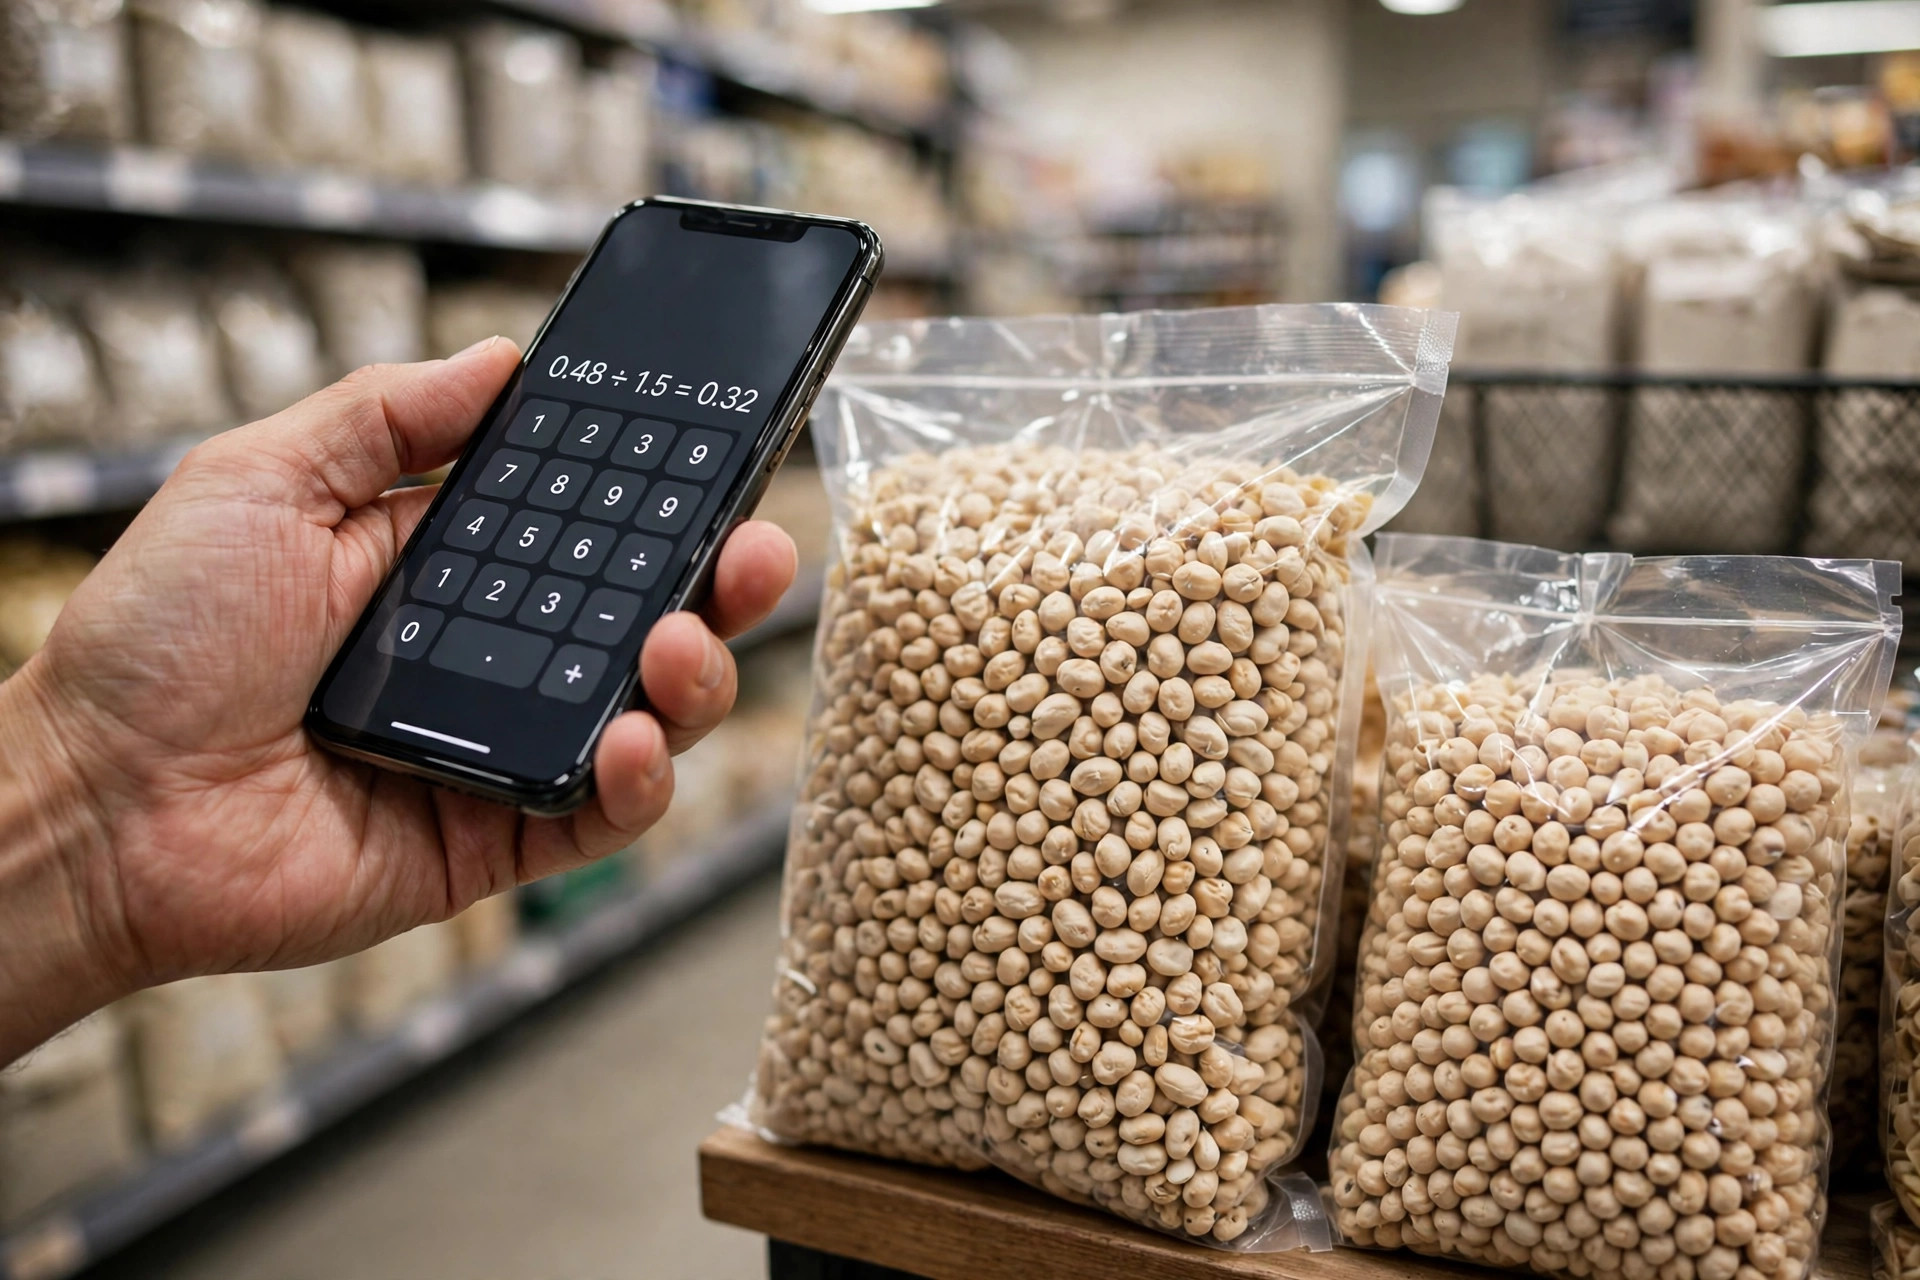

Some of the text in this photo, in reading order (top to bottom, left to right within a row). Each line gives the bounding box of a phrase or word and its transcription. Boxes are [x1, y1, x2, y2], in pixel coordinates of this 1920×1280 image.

[548, 355, 759, 414] 0.48 ÷ 1.5 = 0.32
[532, 414, 546, 433] 1
[579, 423, 600, 444] 2
[633, 433, 654, 454] 3
[688, 444, 708, 465] 9
[498, 463, 519, 483] 7
[550, 474, 570, 495] 8
[603, 485, 623, 506] 9
[658, 496, 679, 518] 9
[466, 515, 486, 536] 4
[518, 526, 540, 548] 5
[573, 538, 593, 560] 6
[630, 552, 647, 571] ÷
[437, 567, 452, 588] 1
[485, 579, 506, 602] 2
[540, 591, 562, 614] 3
[400, 621, 420, 645] 0
[564, 664, 583, 684] +
